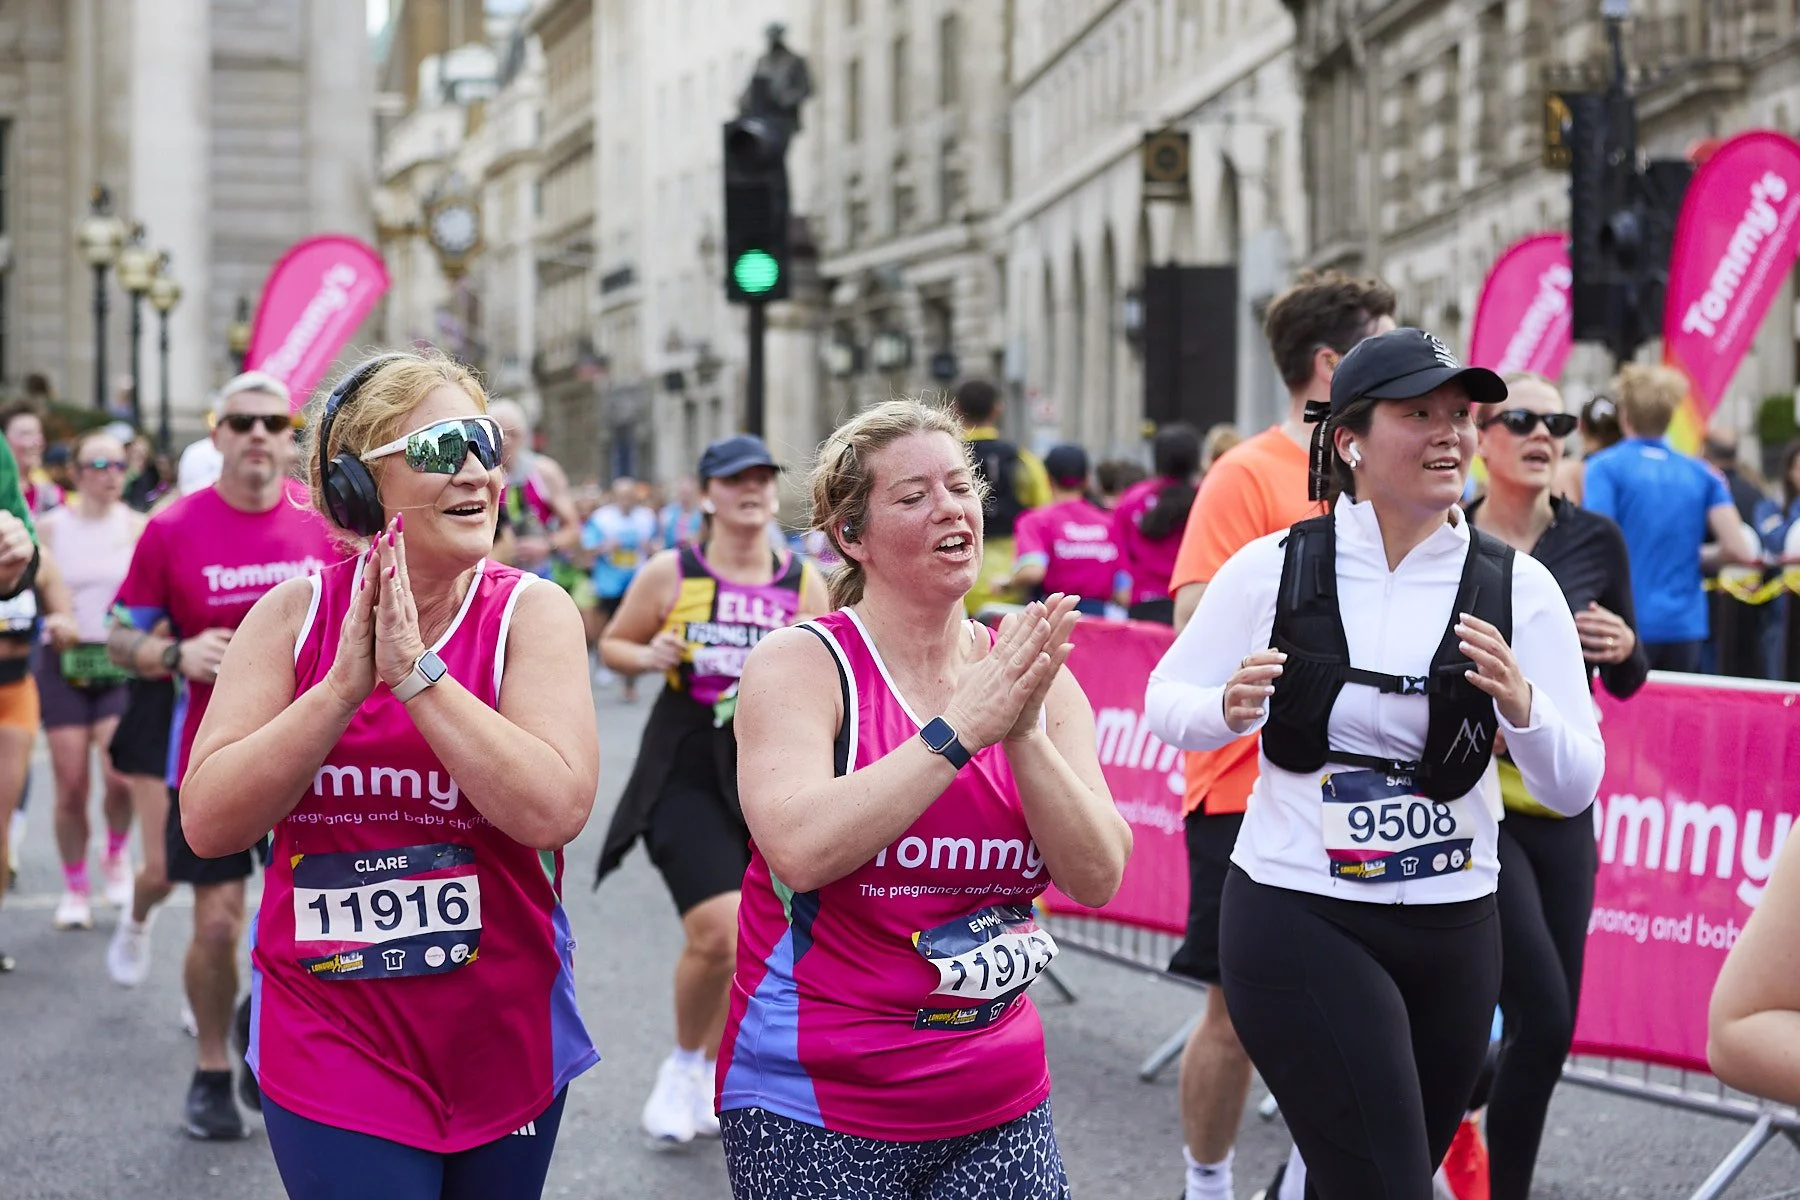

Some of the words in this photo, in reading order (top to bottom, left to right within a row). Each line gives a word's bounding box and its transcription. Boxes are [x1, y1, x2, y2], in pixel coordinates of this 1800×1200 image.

[1682, 171, 1787, 338] Tommy's
[368, 810, 399, 821] and
[404, 811, 444, 825] baby
[1348, 802, 1457, 843] 9508
[354, 855, 409, 873] CLARE
[875, 836, 1045, 879] ommy
[308, 881, 470, 935] 11916
[859, 884, 886, 897] The
[889, 884, 961, 898] pregnancy
[964, 883, 992, 895] and
[1587, 907, 1650, 944] nancy
[1652, 911, 1693, 944] and
[1696, 914, 1741, 950] bab
